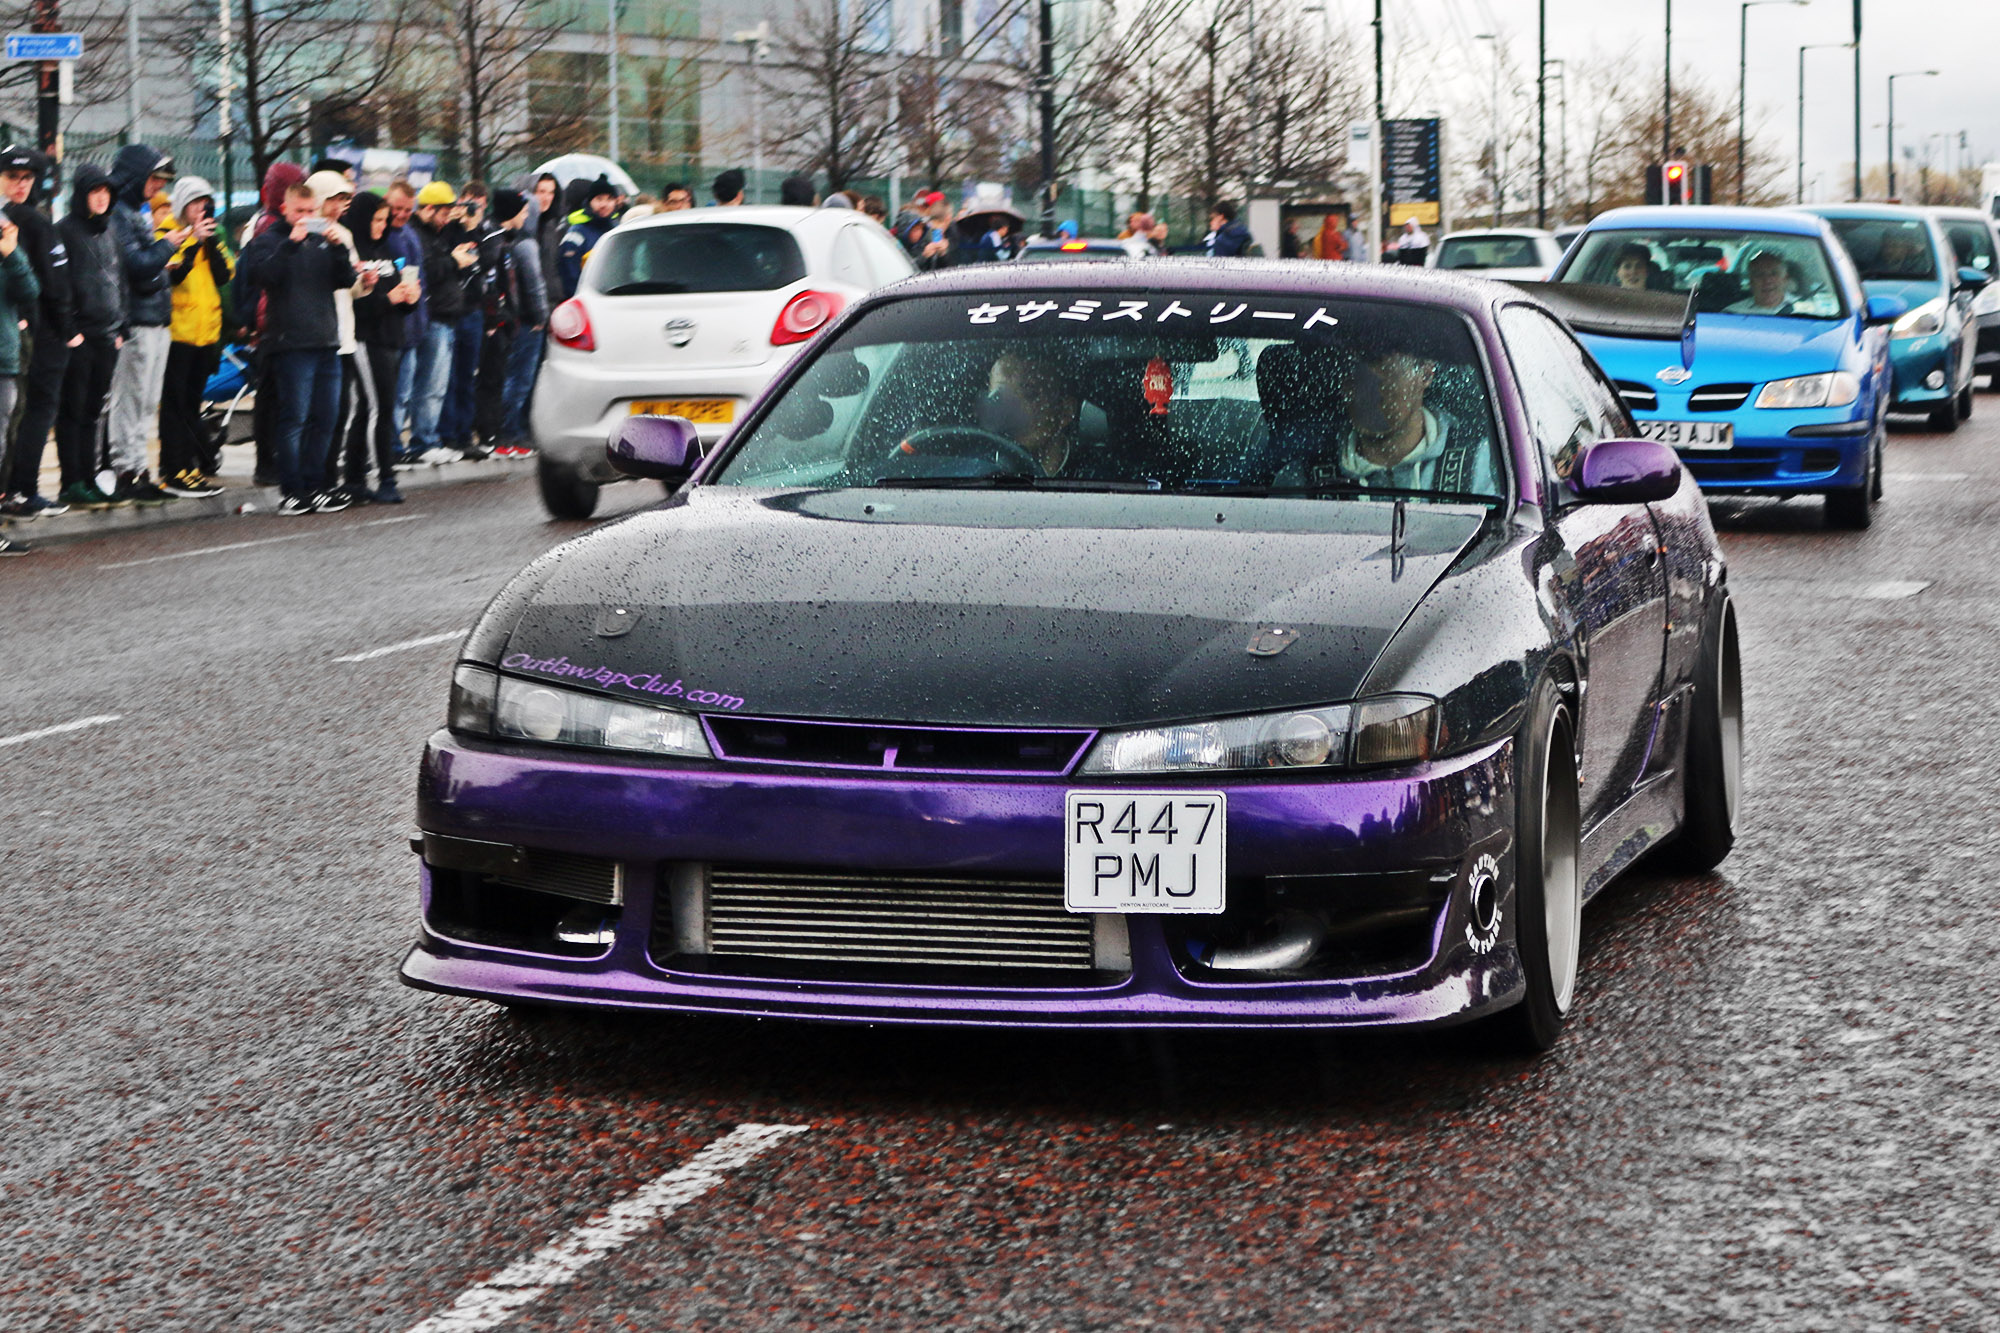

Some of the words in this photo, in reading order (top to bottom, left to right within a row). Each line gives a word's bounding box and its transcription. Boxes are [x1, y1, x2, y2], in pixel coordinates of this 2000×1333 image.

[967, 300, 1339, 330] セサミストリート
[501, 653, 744, 710] OutlawJapClub.com
[1076, 801, 1215, 844] R447
[1094, 853, 1197, 897] PMJ
